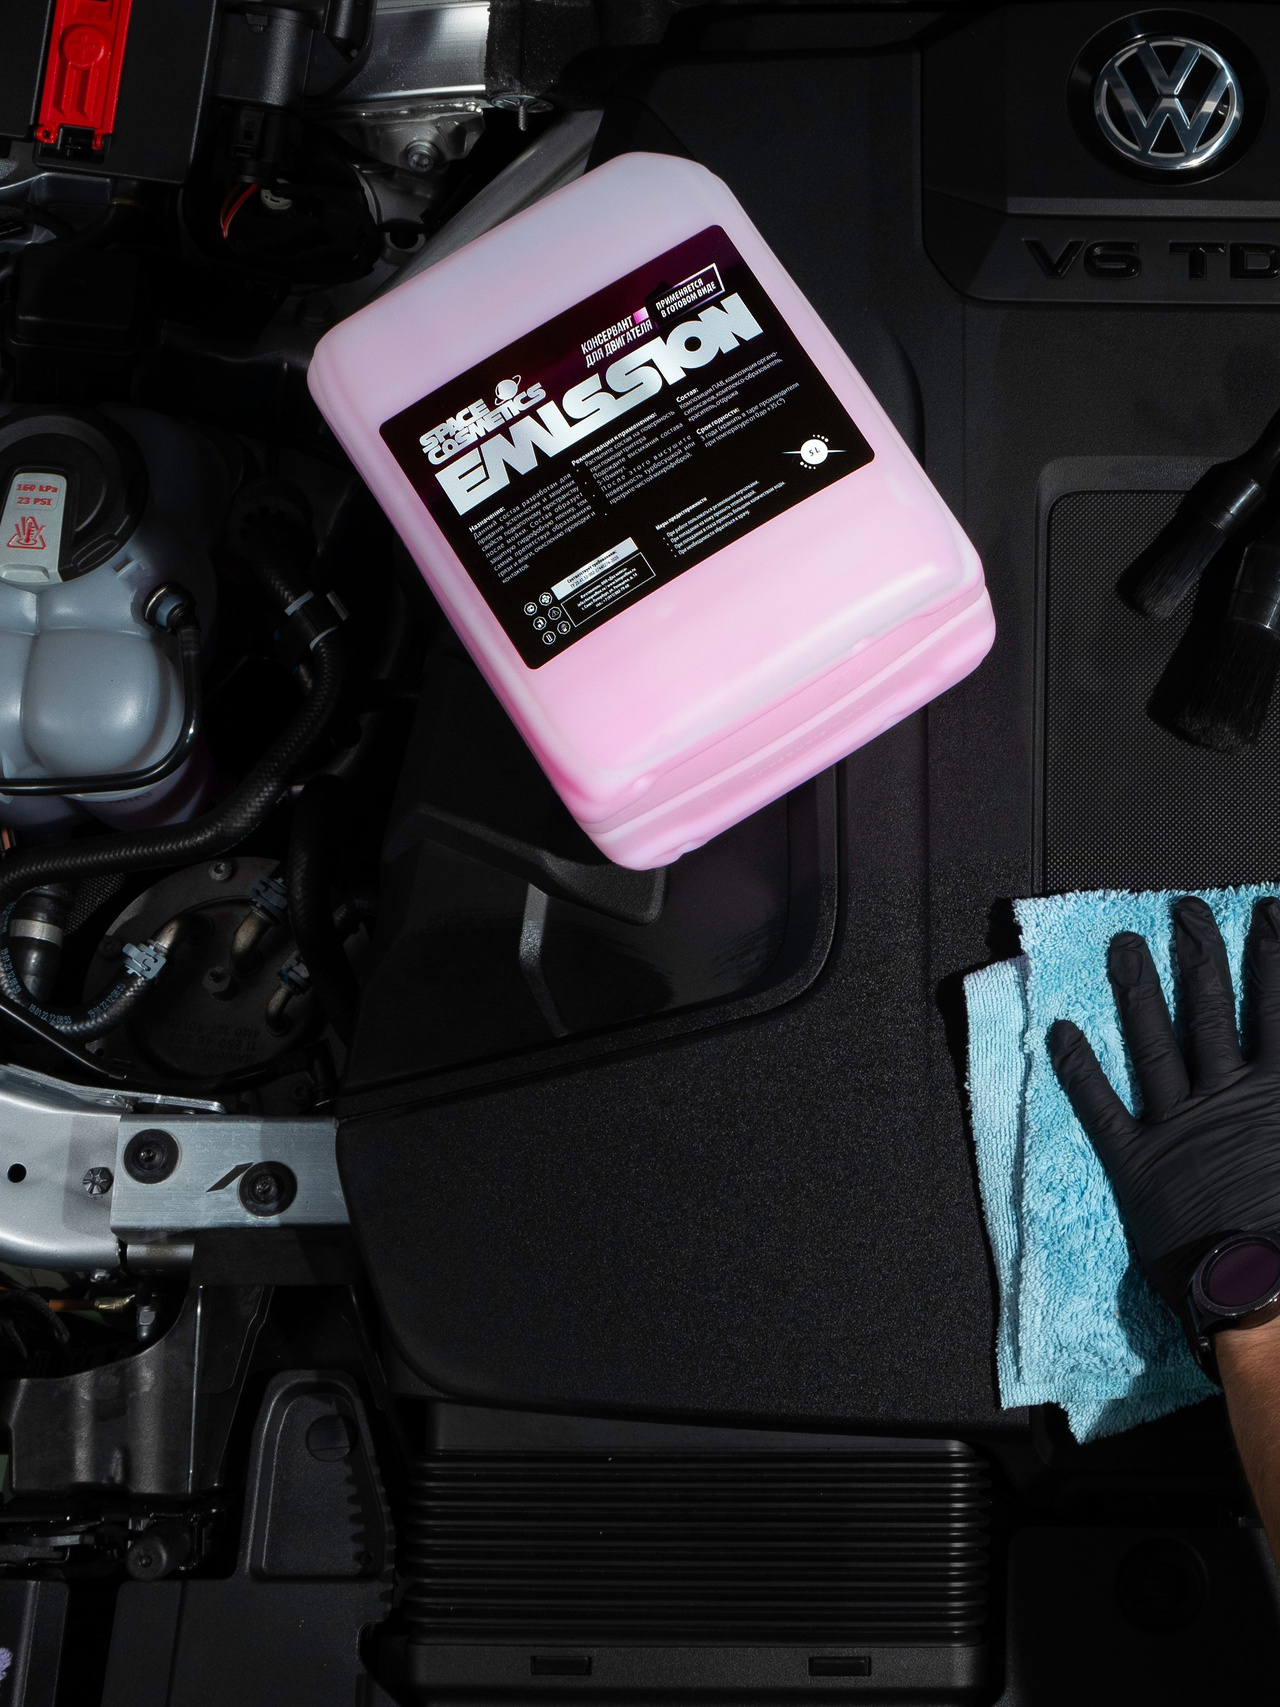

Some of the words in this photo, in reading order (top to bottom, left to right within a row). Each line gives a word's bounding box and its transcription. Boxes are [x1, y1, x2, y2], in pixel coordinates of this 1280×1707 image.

[1022, 238, 1142, 279] V6
[655, 278, 704, 310] ПРИМЕНЯЕТСЯ
[661, 310, 667, 318] В
[666, 292, 698, 315] ГОТОВОМ
[697, 281, 716, 297] ВИДЕ
[581, 315, 633, 355] КОНСЕРВАНТ
[585, 348, 604, 368] ДЛЯ
[604, 319, 653, 357] ДВИГАТЕЛЯ
[434, 292, 763, 516] EMISSION
[676, 388, 699, 403] Состав:
[679, 388, 713, 409] Композиция
[711, 380, 726, 391] ПАВ,
[725, 362, 758, 383] композиция
[757, 352, 778, 365] органо-
[419, 398, 490, 454] SPACE
[424, 382, 546, 465] COSMETICS
[696, 423, 712, 435] Срок
[711, 407, 740, 426] годности:
[705, 429, 718, 438] года
[717, 416, 742, 431] (хранить
[746, 405, 759, 414] таре
[759, 382, 799, 407] производителя
[571, 438, 615, 466] Рекомендации
[617, 412, 657, 438] применению:
[584, 447, 613, 467] Распылите
[614, 436, 632, 449] состав
[640, 411, 675, 433] поверхность
[592, 457, 626, 479] Подождите
[627, 437, 659, 458] высыхания
[660, 423, 683, 438] состава
[601, 475, 625, 492] После
[629, 460, 651, 475] этого
[653, 435, 691, 460] высушите
[17, 484, 36, 492] 160
[39, 485, 58, 493] kPa
[605, 474, 643, 498] поверхность
[644, 449, 683, 474] турбосушкой
[683, 441, 695, 451] или
[17, 497, 31, 505] 23
[33, 498, 52, 506] PSI
[469, 506, 505, 533] Назначение:
[473, 520, 498, 540] Данный
[499, 506, 520, 522] состав
[521, 482, 558, 508] разработан
[560, 473, 571, 484] для
[485, 543, 504, 558] после
[506, 528, 528, 544] мойки.
[529, 512, 553, 528] Состав
[554, 492, 583, 513] образует
[655, 520, 669, 530] Меры
[668, 497, 707, 523] предосторожности
